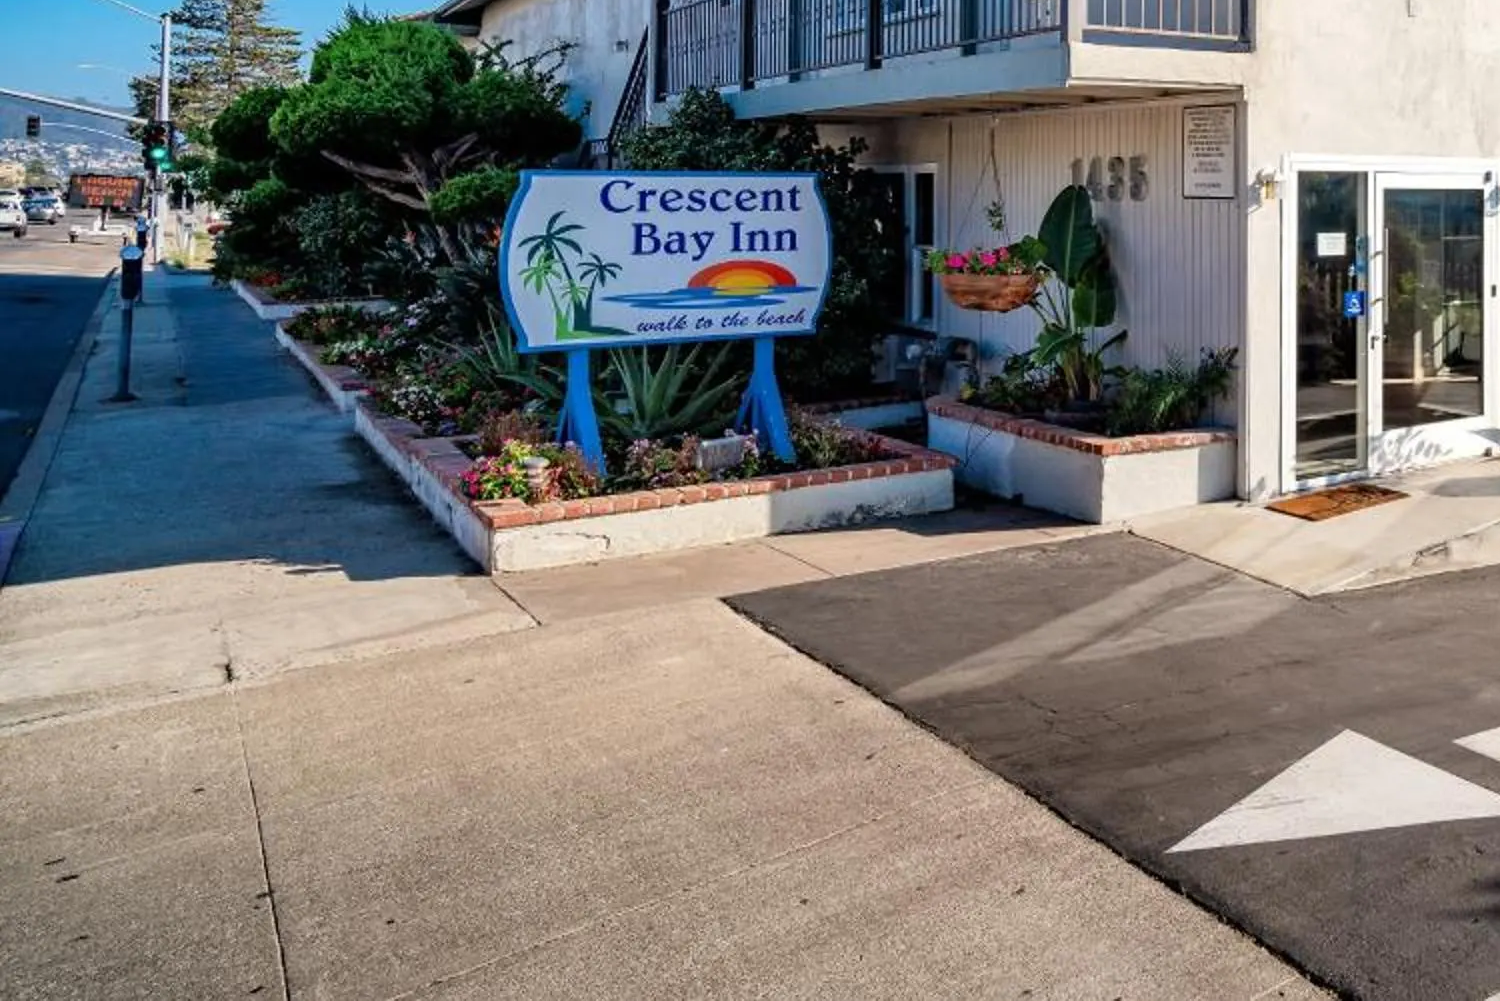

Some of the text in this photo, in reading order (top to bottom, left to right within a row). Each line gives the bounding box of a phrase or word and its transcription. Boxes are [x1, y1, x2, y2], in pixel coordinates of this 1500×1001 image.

[599, 179, 802, 214] Crescent
[631, 220, 799, 261] Bay Inn
[636, 308, 806, 333] walk to the beach
